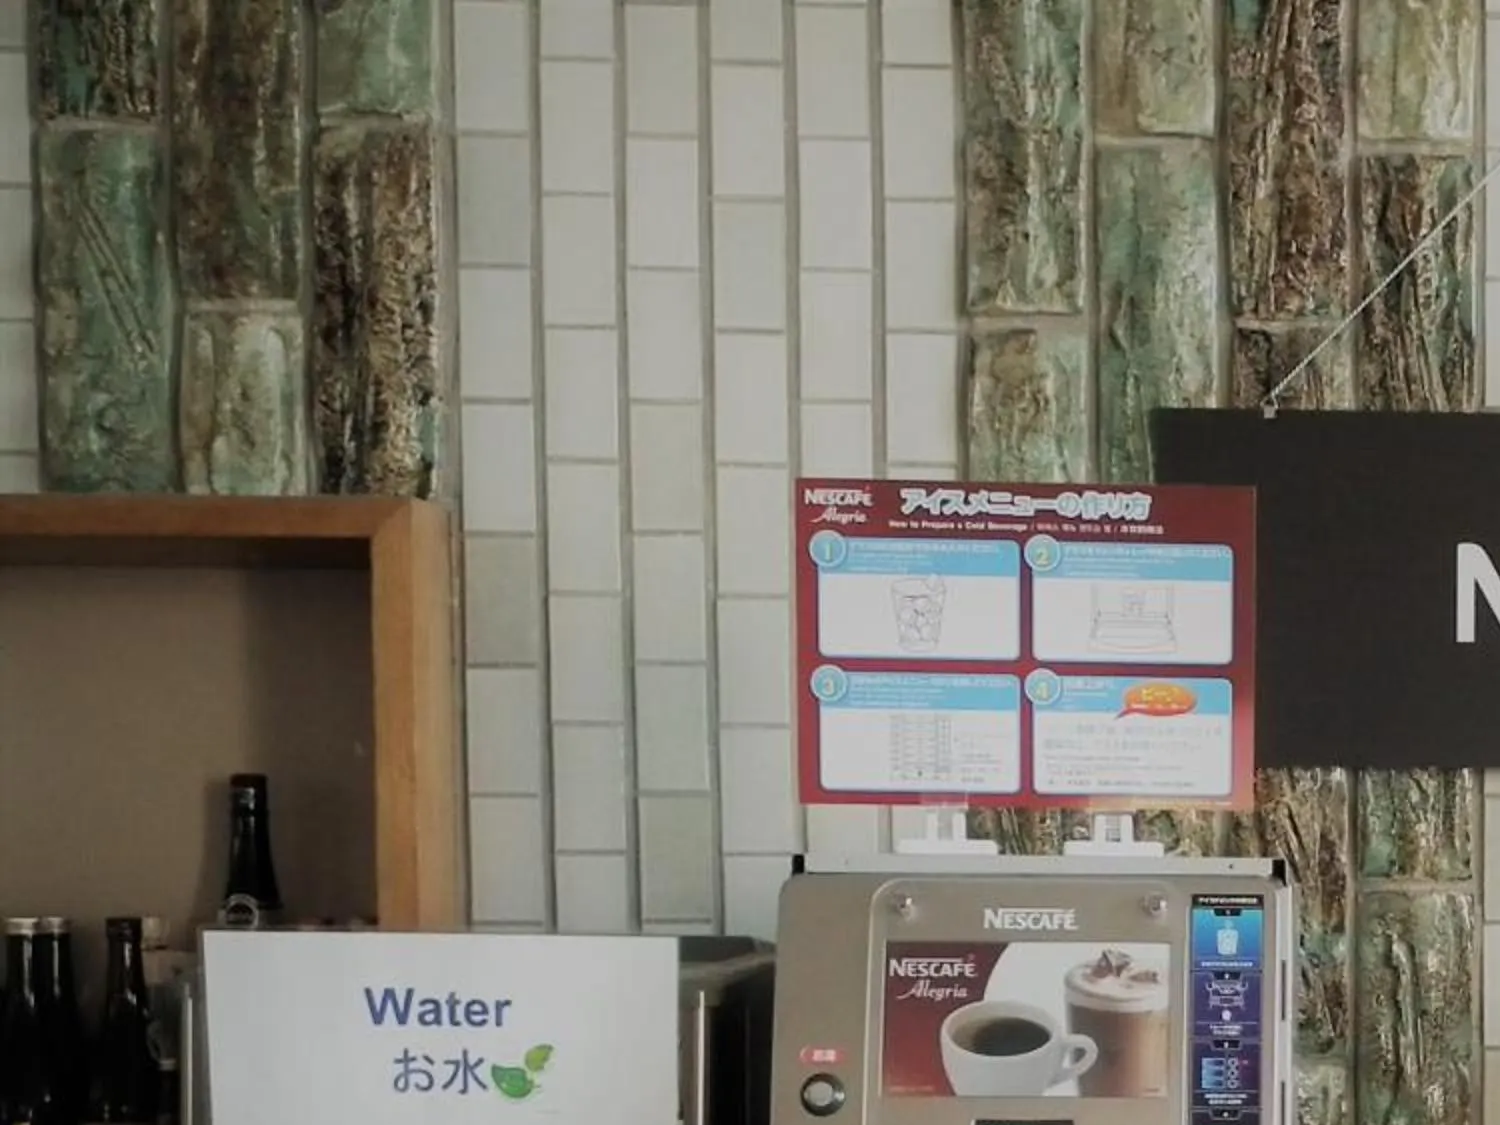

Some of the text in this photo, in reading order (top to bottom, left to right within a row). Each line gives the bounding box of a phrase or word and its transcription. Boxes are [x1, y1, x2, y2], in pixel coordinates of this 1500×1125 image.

[811, 507, 867, 525] Alegria
[897, 979, 968, 1001] Alegria
[365, 987, 512, 1028] Water
[392, 1047, 488, 1095] お水
